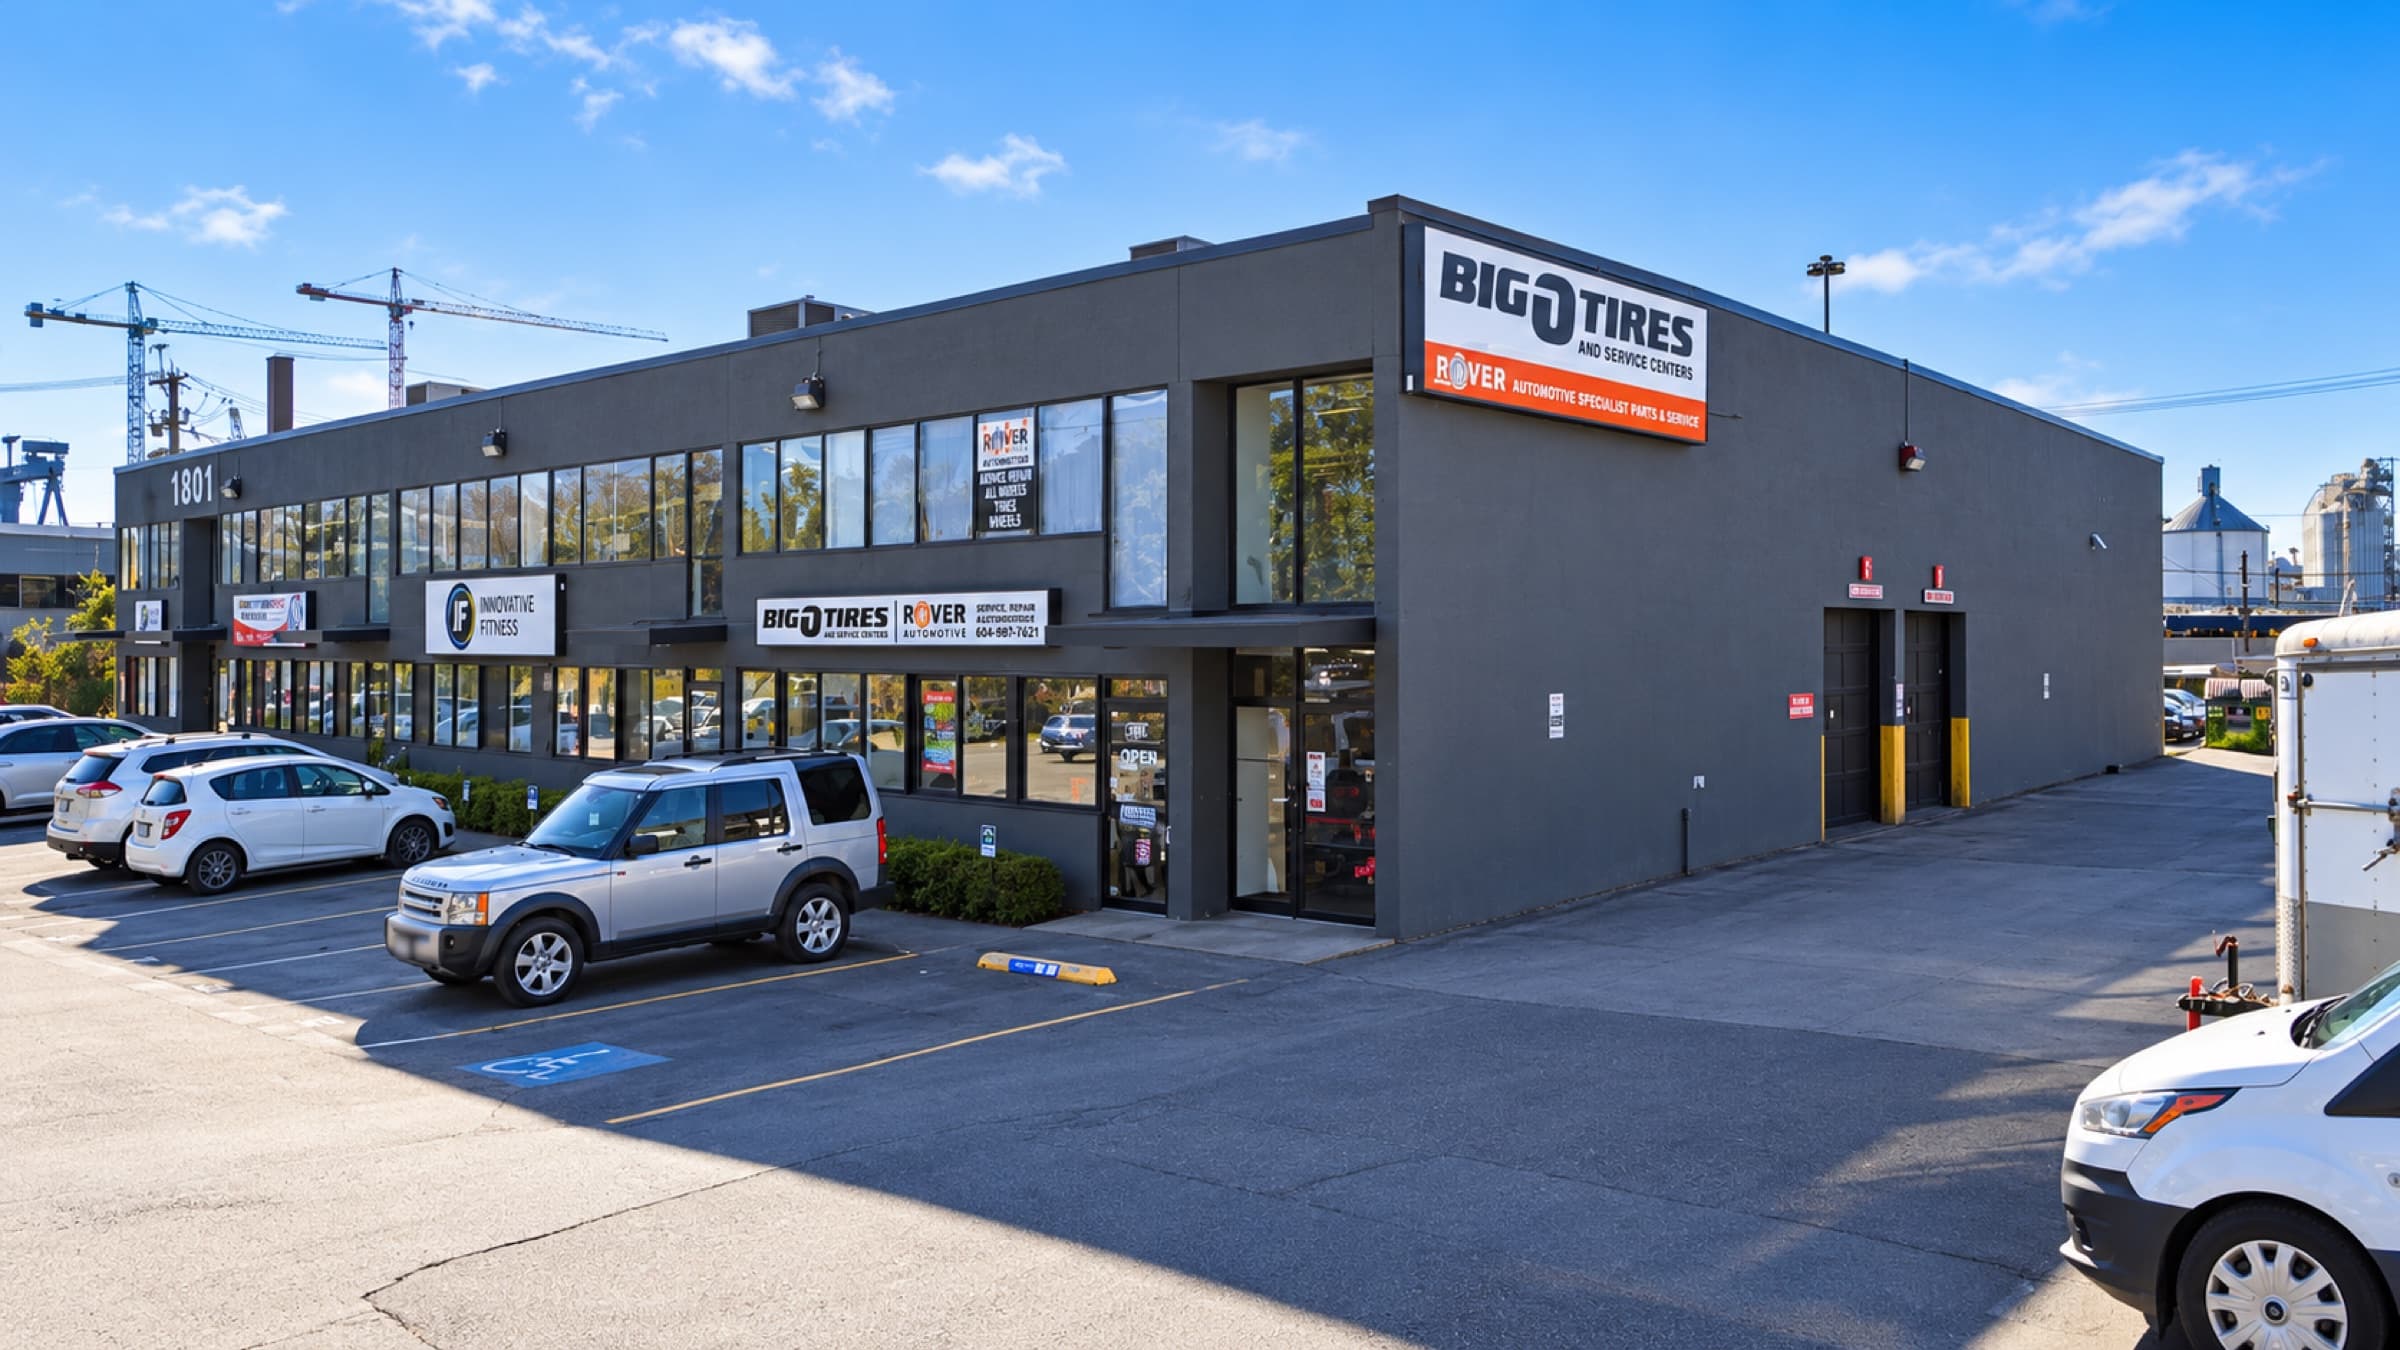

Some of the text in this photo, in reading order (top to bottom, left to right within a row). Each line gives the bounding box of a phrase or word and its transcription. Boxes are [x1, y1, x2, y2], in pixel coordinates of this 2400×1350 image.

[1440, 250, 1530, 318] BIG
[1579, 288, 1694, 358] TIRES
[1436, 351, 1507, 393] ROVER
[1578, 339, 1694, 381] AND SERVICE CENTERS
[1512, 378, 1577, 405] AUTOMOTIVE
[1578, 392, 1629, 417] SPECIALIST
[1630, 402, 1658, 422] PARTS
[1666, 409, 1700, 429] SERVICE
[171, 463, 213, 506] 1801
[480, 594, 535, 614] INNOVATIVE
[763, 608, 800, 629] BIG
[824, 606, 889, 628] TIRES
[903, 600, 966, 629] ROVER
[480, 618, 519, 637] FITNESS
[903, 627, 967, 639] AUTOMOTIVE
[1120, 748, 1158, 766] OPEN
